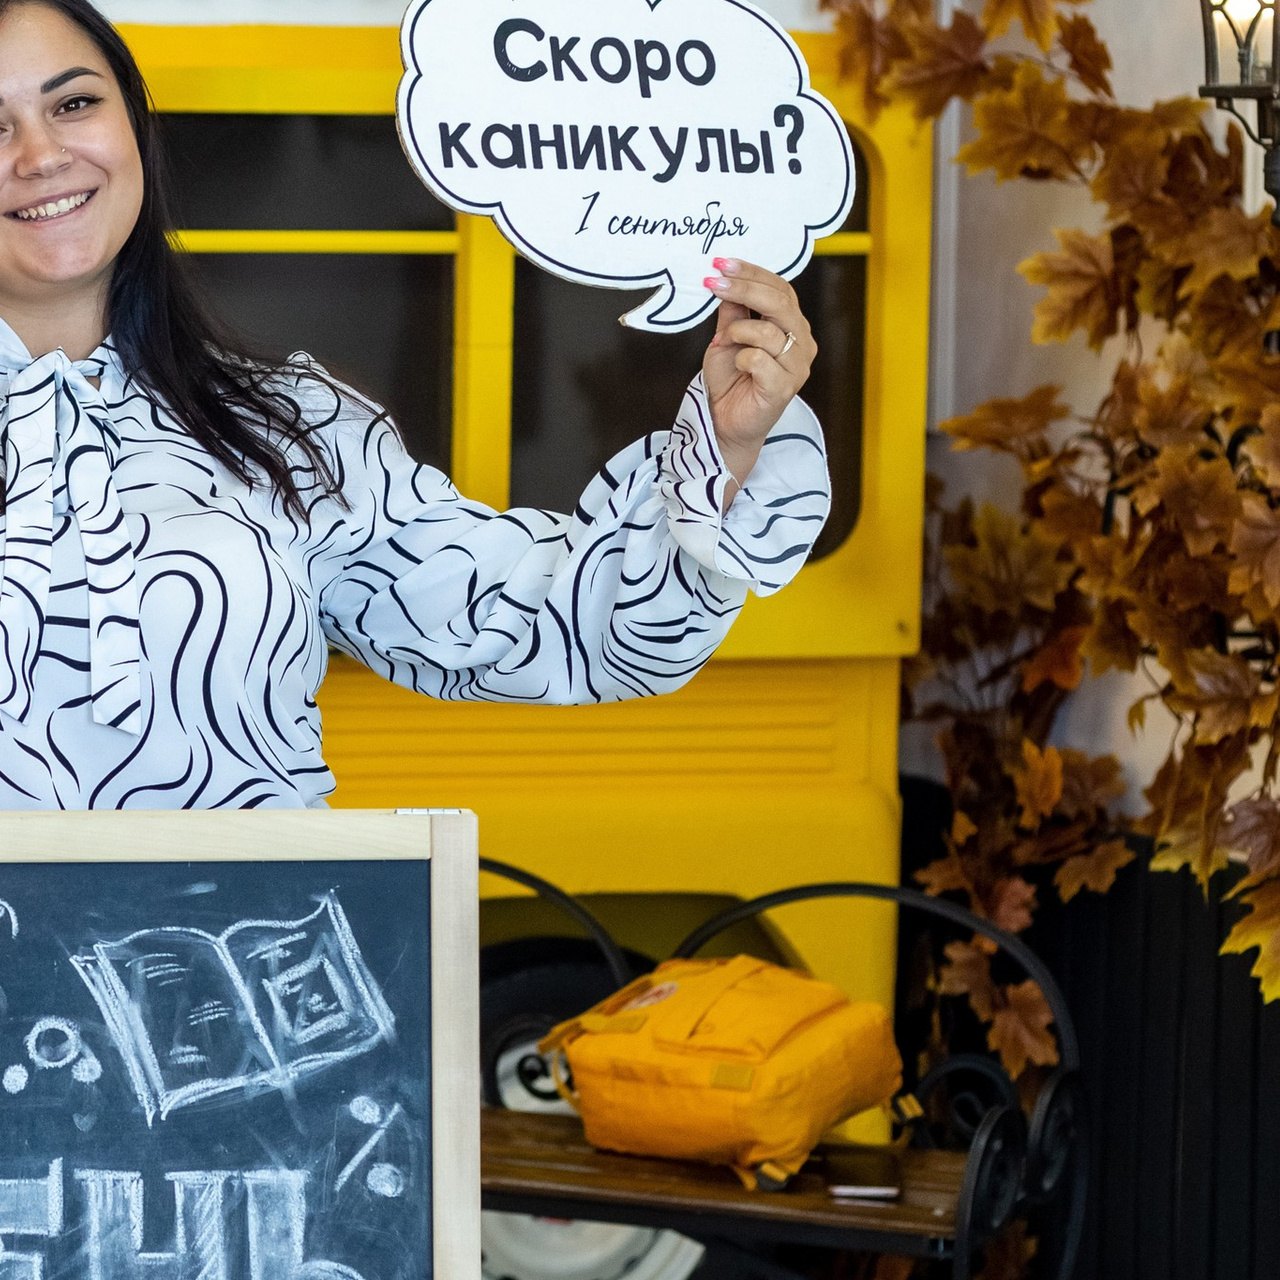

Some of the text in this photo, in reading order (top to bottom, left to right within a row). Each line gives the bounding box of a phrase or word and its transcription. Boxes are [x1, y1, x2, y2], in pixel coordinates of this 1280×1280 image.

[493, 18, 716, 98] Скоро
[438, 104, 805, 183] каникулы?
[575, 191, 750, 254] 1 сентября
